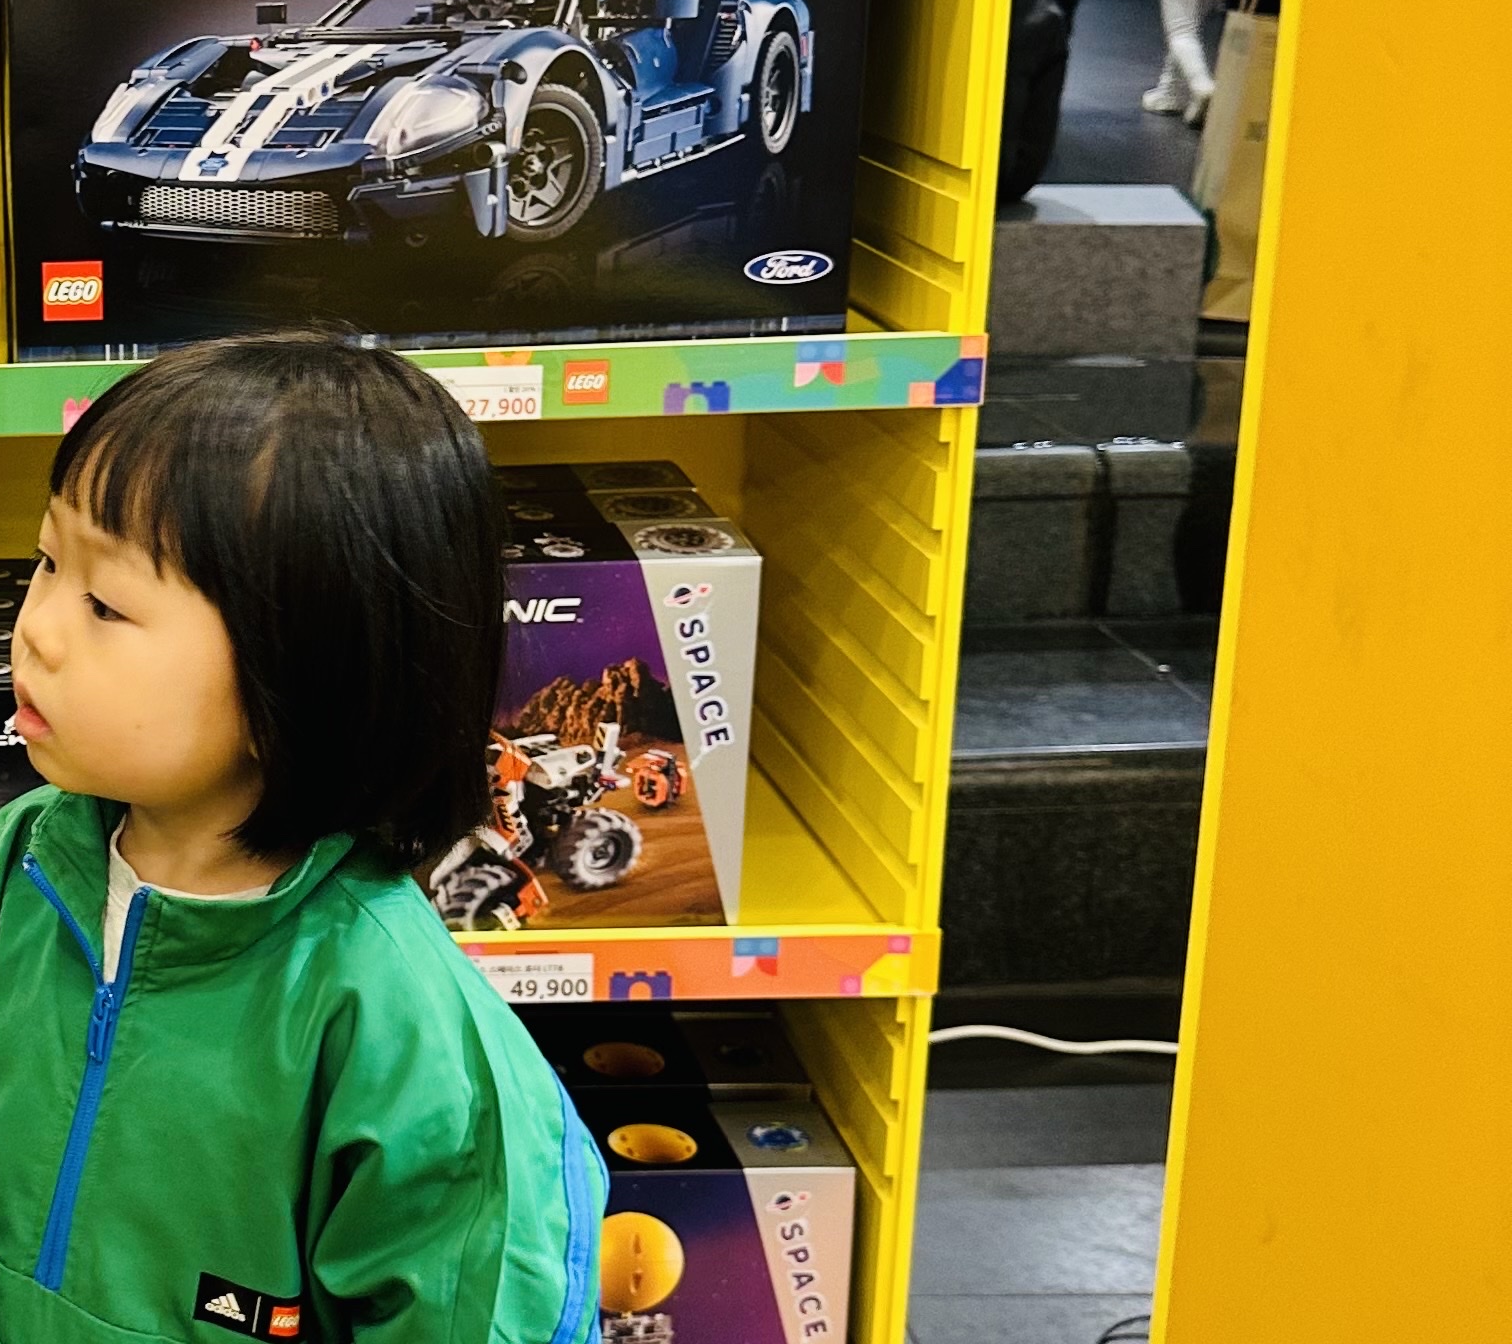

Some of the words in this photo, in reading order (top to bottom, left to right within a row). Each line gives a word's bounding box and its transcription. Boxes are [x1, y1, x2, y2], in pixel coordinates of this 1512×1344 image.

[759, 255, 819, 280] Ford
[47, 278, 99, 303] LEGO
[567, 373, 606, 391] LEGO
[458, 397, 537, 418] 27,900
[676, 617, 734, 748] SPACE
[510, 978, 589, 1000] 49,900
[779, 1221, 830, 1339] SPACE
[271, 1314, 301, 1329] LEGO
